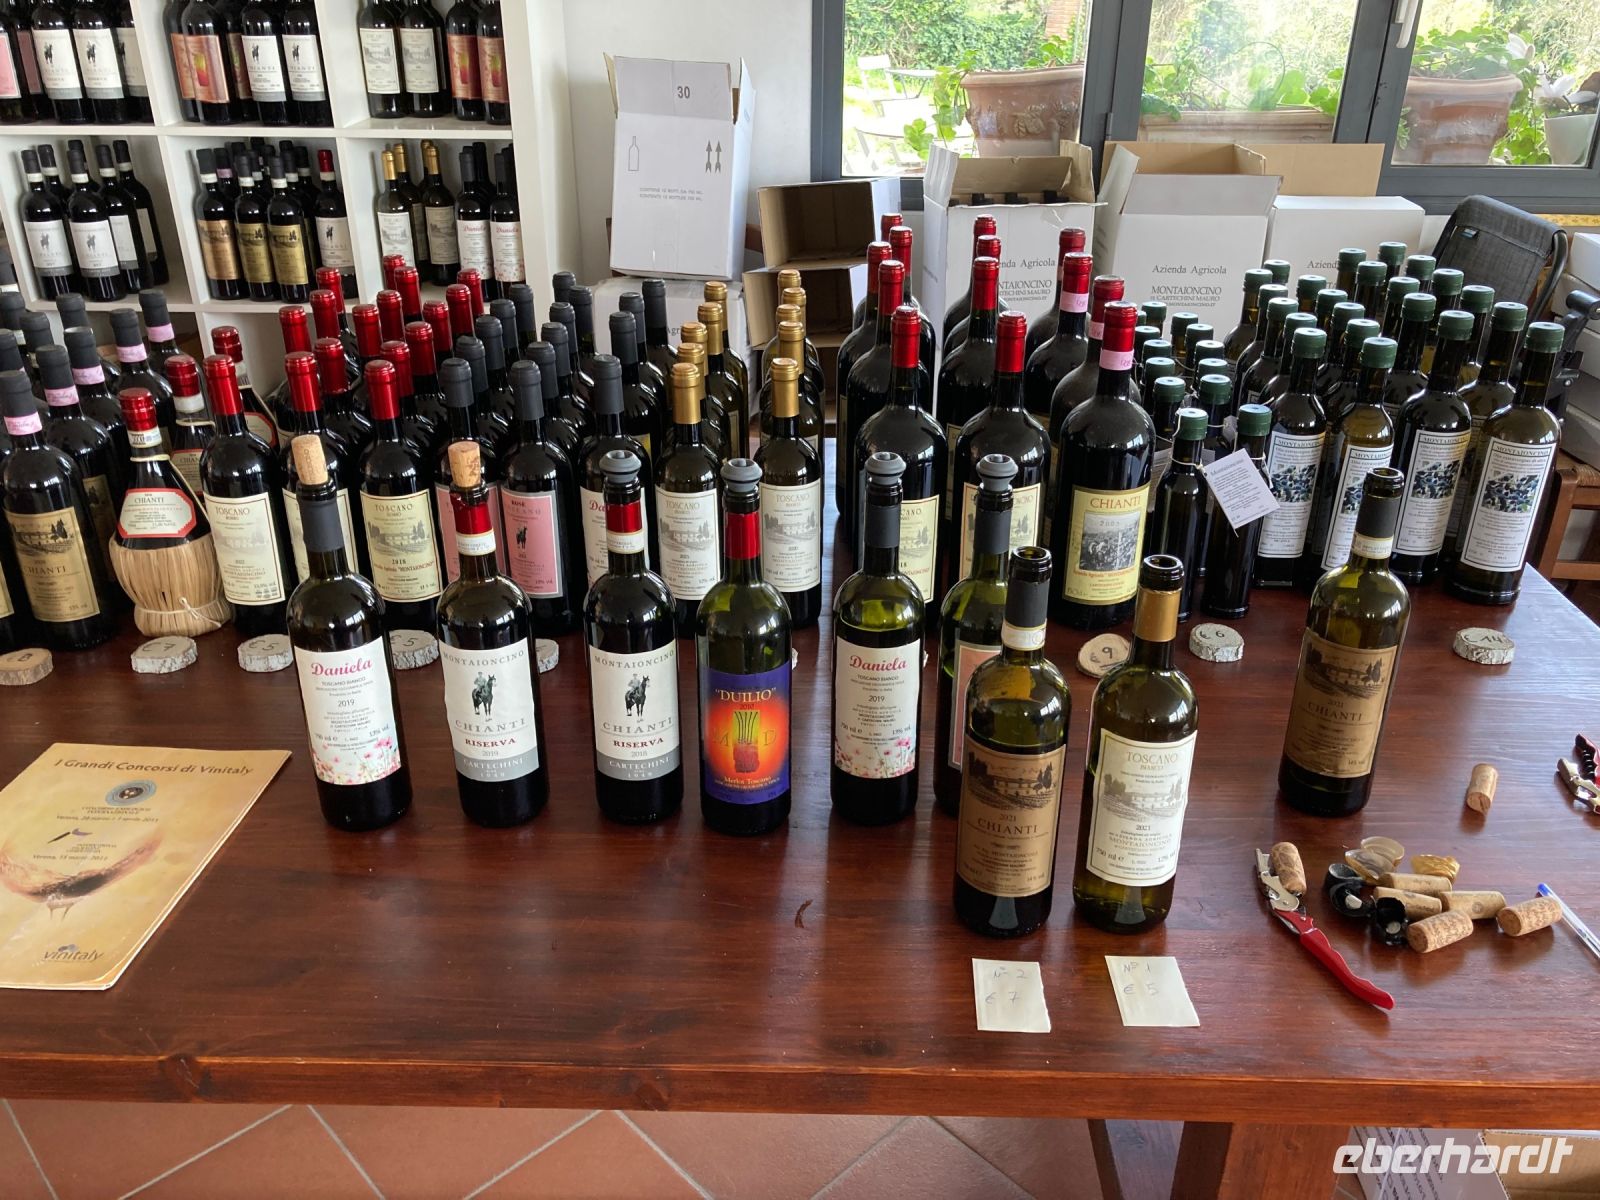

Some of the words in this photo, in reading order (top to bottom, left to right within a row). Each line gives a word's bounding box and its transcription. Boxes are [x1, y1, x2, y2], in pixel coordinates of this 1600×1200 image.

[677, 86, 690, 99] 30
[1020, 258, 1055, 270] Agricola
[1152, 265, 1187, 274] Azienda
[1191, 266, 1227, 275] Agricola
[1307, 260, 1338, 269] Aziend
[999, 280, 1052, 289] NTAIONCINO
[1151, 286, 1222, 295] MONTAIONCINO
[776, 494, 810, 502] TOSCANO
[1090, 496, 1140, 509] CHIANTI
[215, 507, 250, 515] TOSCANO
[666, 501, 700, 509] TOSCANO
[900, 508, 922, 516] CANO
[163, 643, 176, 651] 7
[263, 642, 279, 651] 5
[402, 638, 418, 647] 5
[443, 650, 524, 666] MONTAIONCINO
[594, 650, 675, 668] MONTAIONCINO
[1101, 647, 1113, 659] 9
[311, 657, 373, 676] Daniela
[850, 655, 908, 671] Daniela
[338, 699, 355, 707] 2019
[1308, 702, 1362, 720] CHIANTI
[455, 718, 526, 733] CHIANTI
[603, 717, 672, 733] CHIANTI
[465, 738, 516, 748] RISERVA
[613, 738, 664, 748] RISERVA
[464, 757, 523, 769] CARTECHINI
[609, 757, 669, 770] CARTECHINI
[1126, 752, 1178, 764] TOSCANO
[54, 759, 61, 767] I
[64, 760, 112, 770] Grandi
[116, 762, 178, 773] Concorsi
[180, 765, 195, 774] di
[200, 766, 254, 775] Vinitaly
[1000, 813, 1017, 822] 2021
[978, 817, 1038, 834] CHIANTI
[1109, 837, 1171, 847] MONTAIONCINO
[43, 950, 103, 962] vinitaly
[1146, 962, 1151, 973] 1
[1016, 969, 1027, 979] 2
[1123, 984, 1134, 995] €
[1147, 984, 1159, 996] 5
[984, 992, 996, 1004] €
[1008, 991, 1020, 1005] 7
